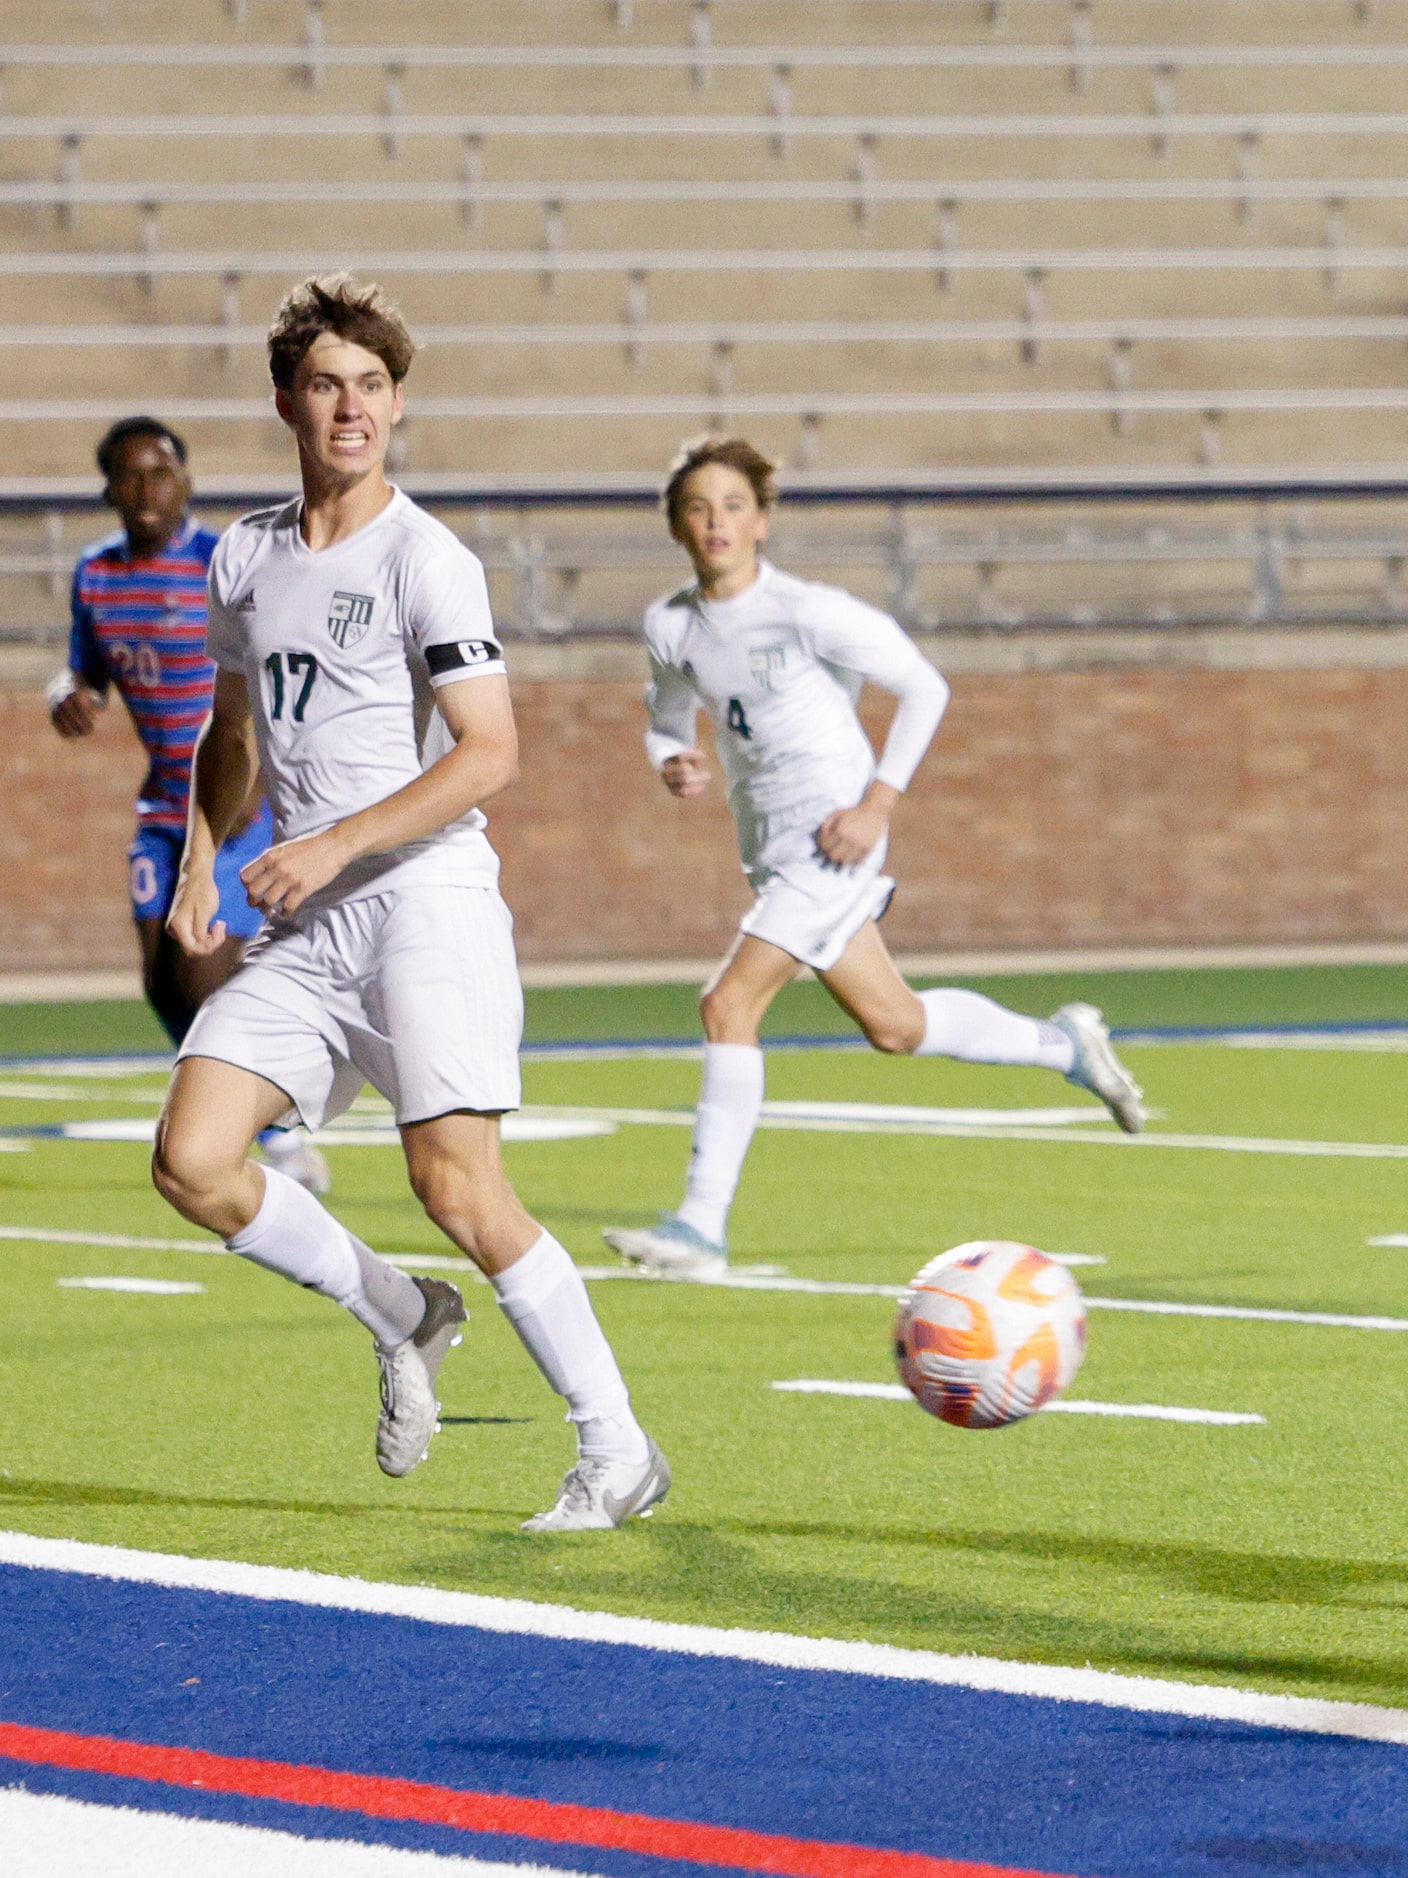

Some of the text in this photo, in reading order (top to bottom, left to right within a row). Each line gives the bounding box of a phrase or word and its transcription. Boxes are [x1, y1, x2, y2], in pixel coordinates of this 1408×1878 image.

[109, 641, 160, 687] 20
[458, 641, 489, 664] C
[265, 652, 317, 722] 17
[728, 698, 752, 740] 4
